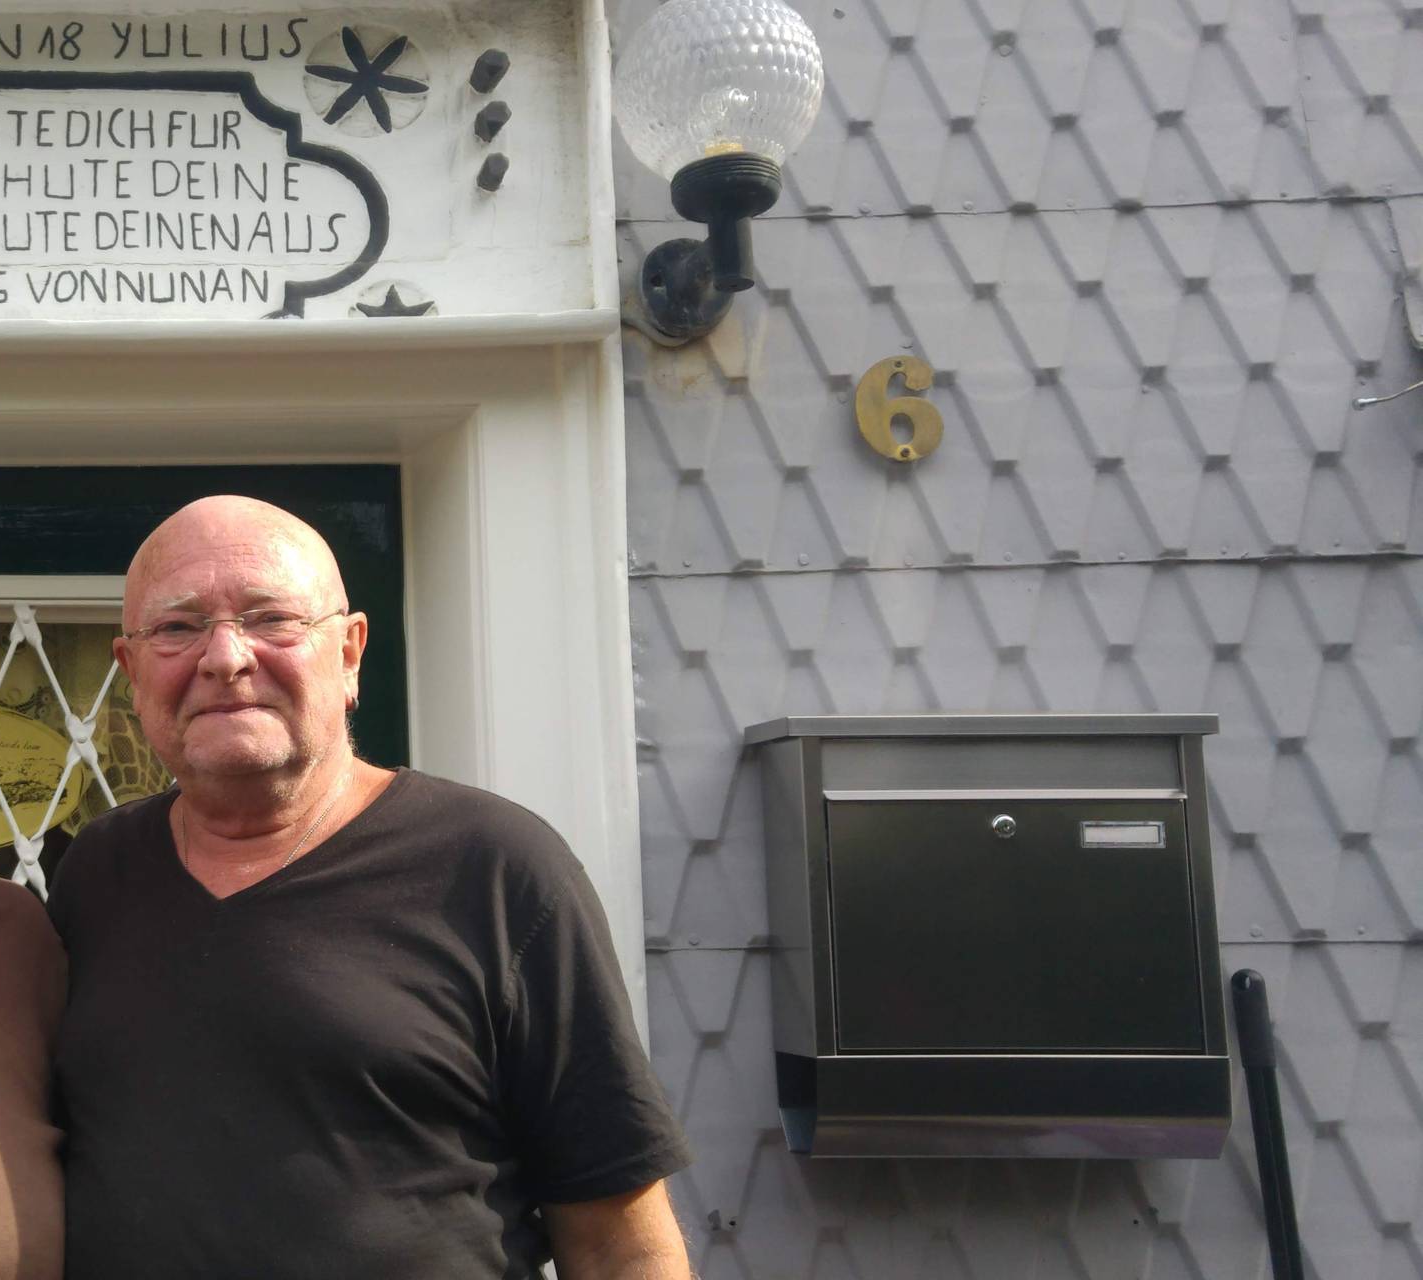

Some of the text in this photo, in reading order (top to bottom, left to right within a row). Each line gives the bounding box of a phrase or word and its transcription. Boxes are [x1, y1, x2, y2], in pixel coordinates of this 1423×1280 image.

[37, 21, 84, 61] 18
[111, 17, 309, 62] YULIUS
[151, 159, 301, 202] DEINE
[855, 355, 944, 462] 6
